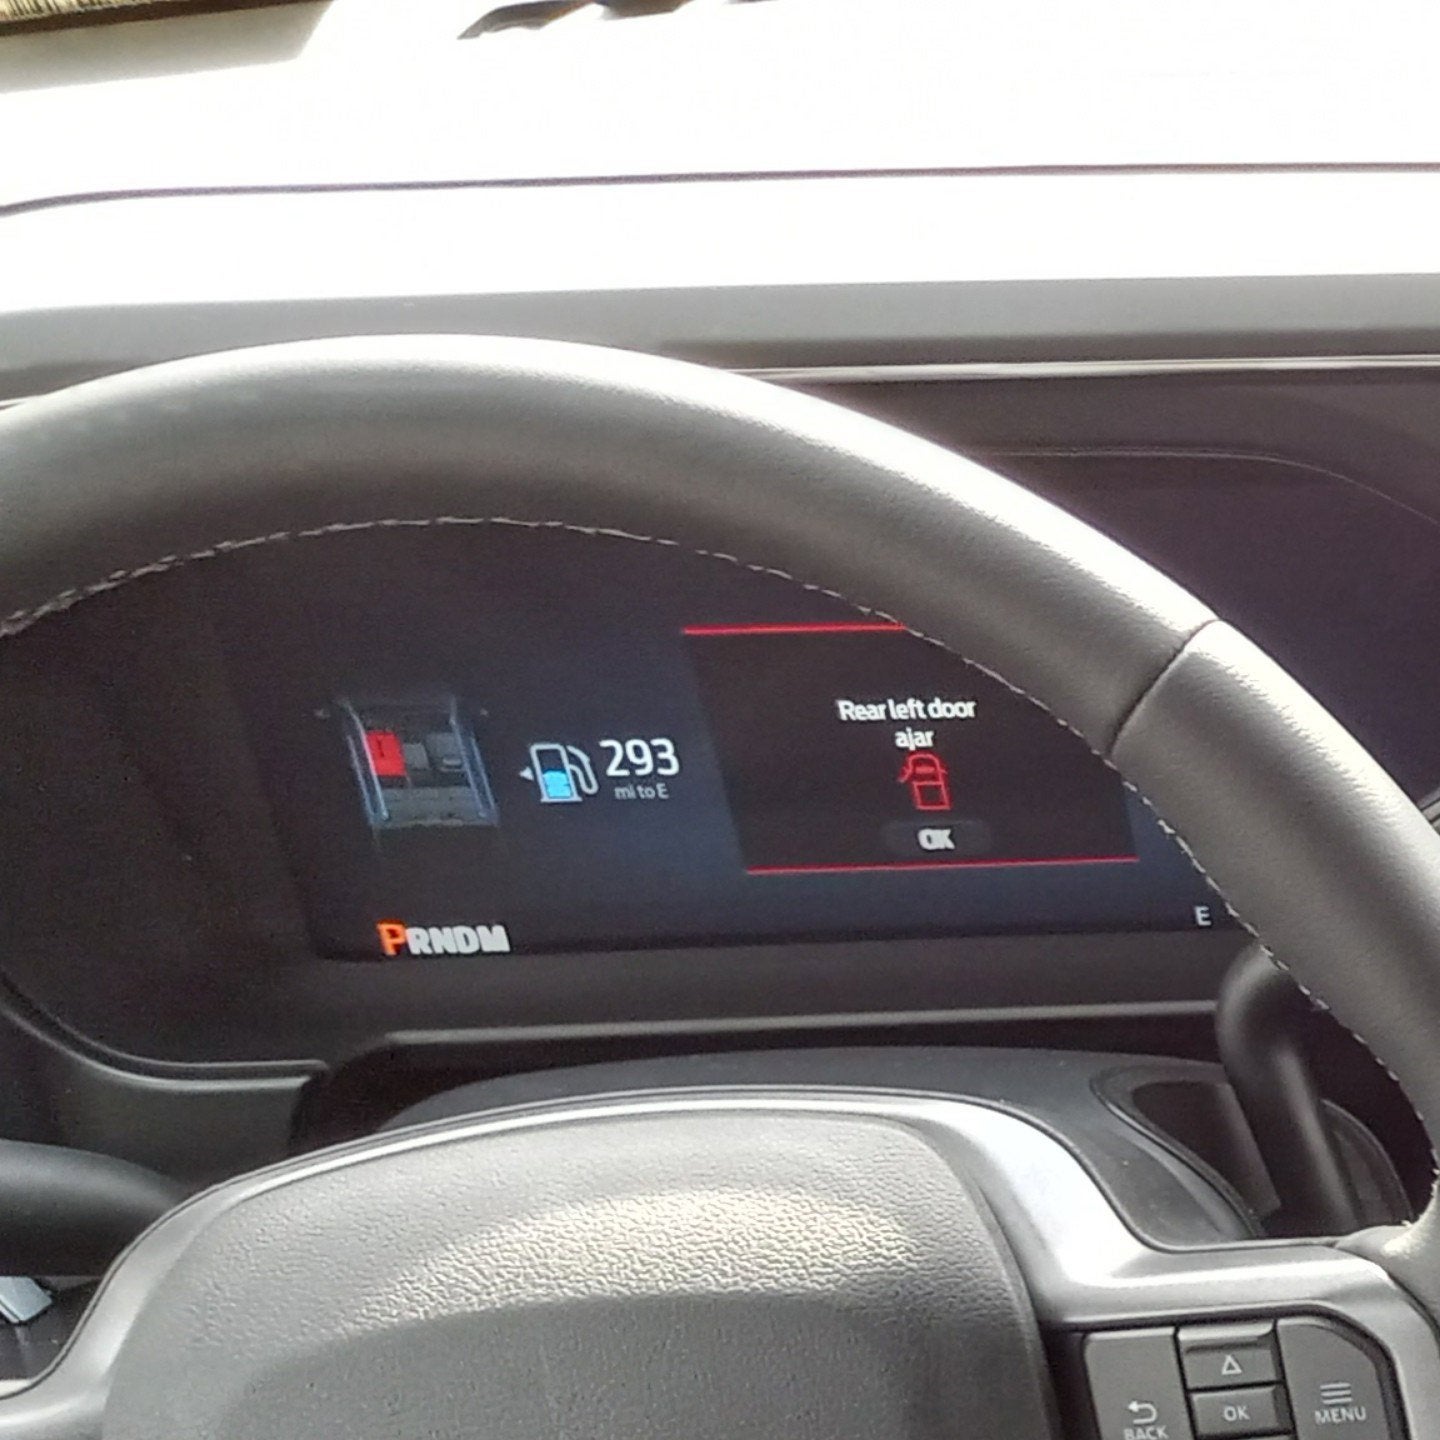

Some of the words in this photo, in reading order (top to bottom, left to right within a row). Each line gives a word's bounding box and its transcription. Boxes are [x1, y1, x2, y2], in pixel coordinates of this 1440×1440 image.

[835, 698, 888, 722] Rear
[889, 697, 927, 721] left
[928, 696, 977, 720] door
[894, 727, 935, 751] ajar
[599, 737, 680, 778] 293
[614, 784, 636, 800] mi
[637, 785, 656, 799] to
[656, 785, 669, 799] E
[917, 827, 956, 851] OK
[1193, 905, 1212, 927] E
[1222, 1404, 1251, 1422] OK
[1314, 1405, 1367, 1425] MENU
